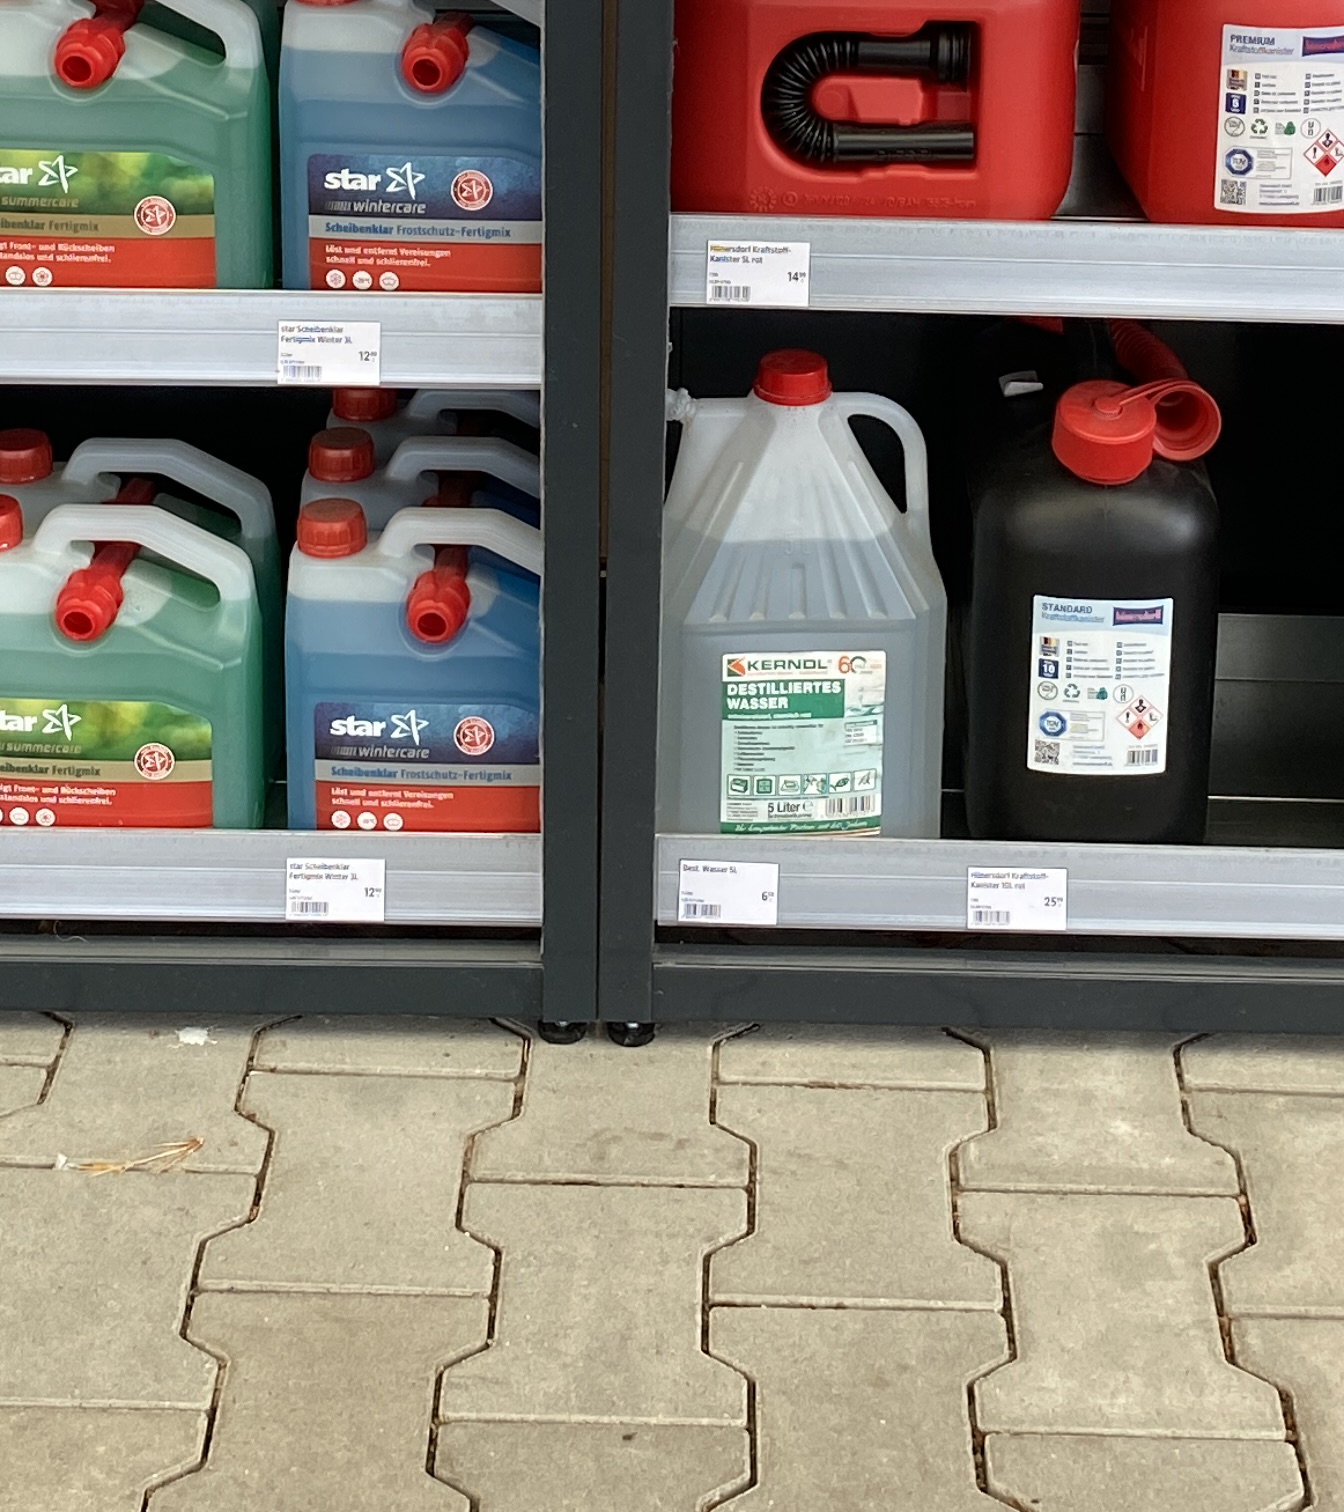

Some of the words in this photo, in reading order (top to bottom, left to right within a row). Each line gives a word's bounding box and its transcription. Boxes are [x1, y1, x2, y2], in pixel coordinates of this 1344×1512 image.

[1230, 34, 1275, 46] PREMIUM
[324, 168, 382, 191] star
[1, 196, 79, 208] summercare
[353, 199, 427, 214] wintercare
[48, 219, 99, 233] Fertigmix
[325, 222, 393, 235] Scheibenklar
[396, 224, 511, 238] Frostschutz-Fertigmix
[1042, 602, 1093, 613] STANDARD
[747, 659, 828, 671] KERNDL
[1043, 663, 1056, 674] 10
[727, 681, 841, 696] DESTILLIERTES
[727, 697, 789, 710] WASSER
[330, 715, 386, 737] star
[6, 743, 82, 754] summercare
[359, 744, 430, 759] wintercare
[52, 764, 101, 777] Fertigmix
[331, 766, 398, 779] Scheibenklar
[401, 768, 512, 781] Frostschutz-Fertigmix
[768, 802, 774, 812] 5
[777, 801, 799, 812] Liter
